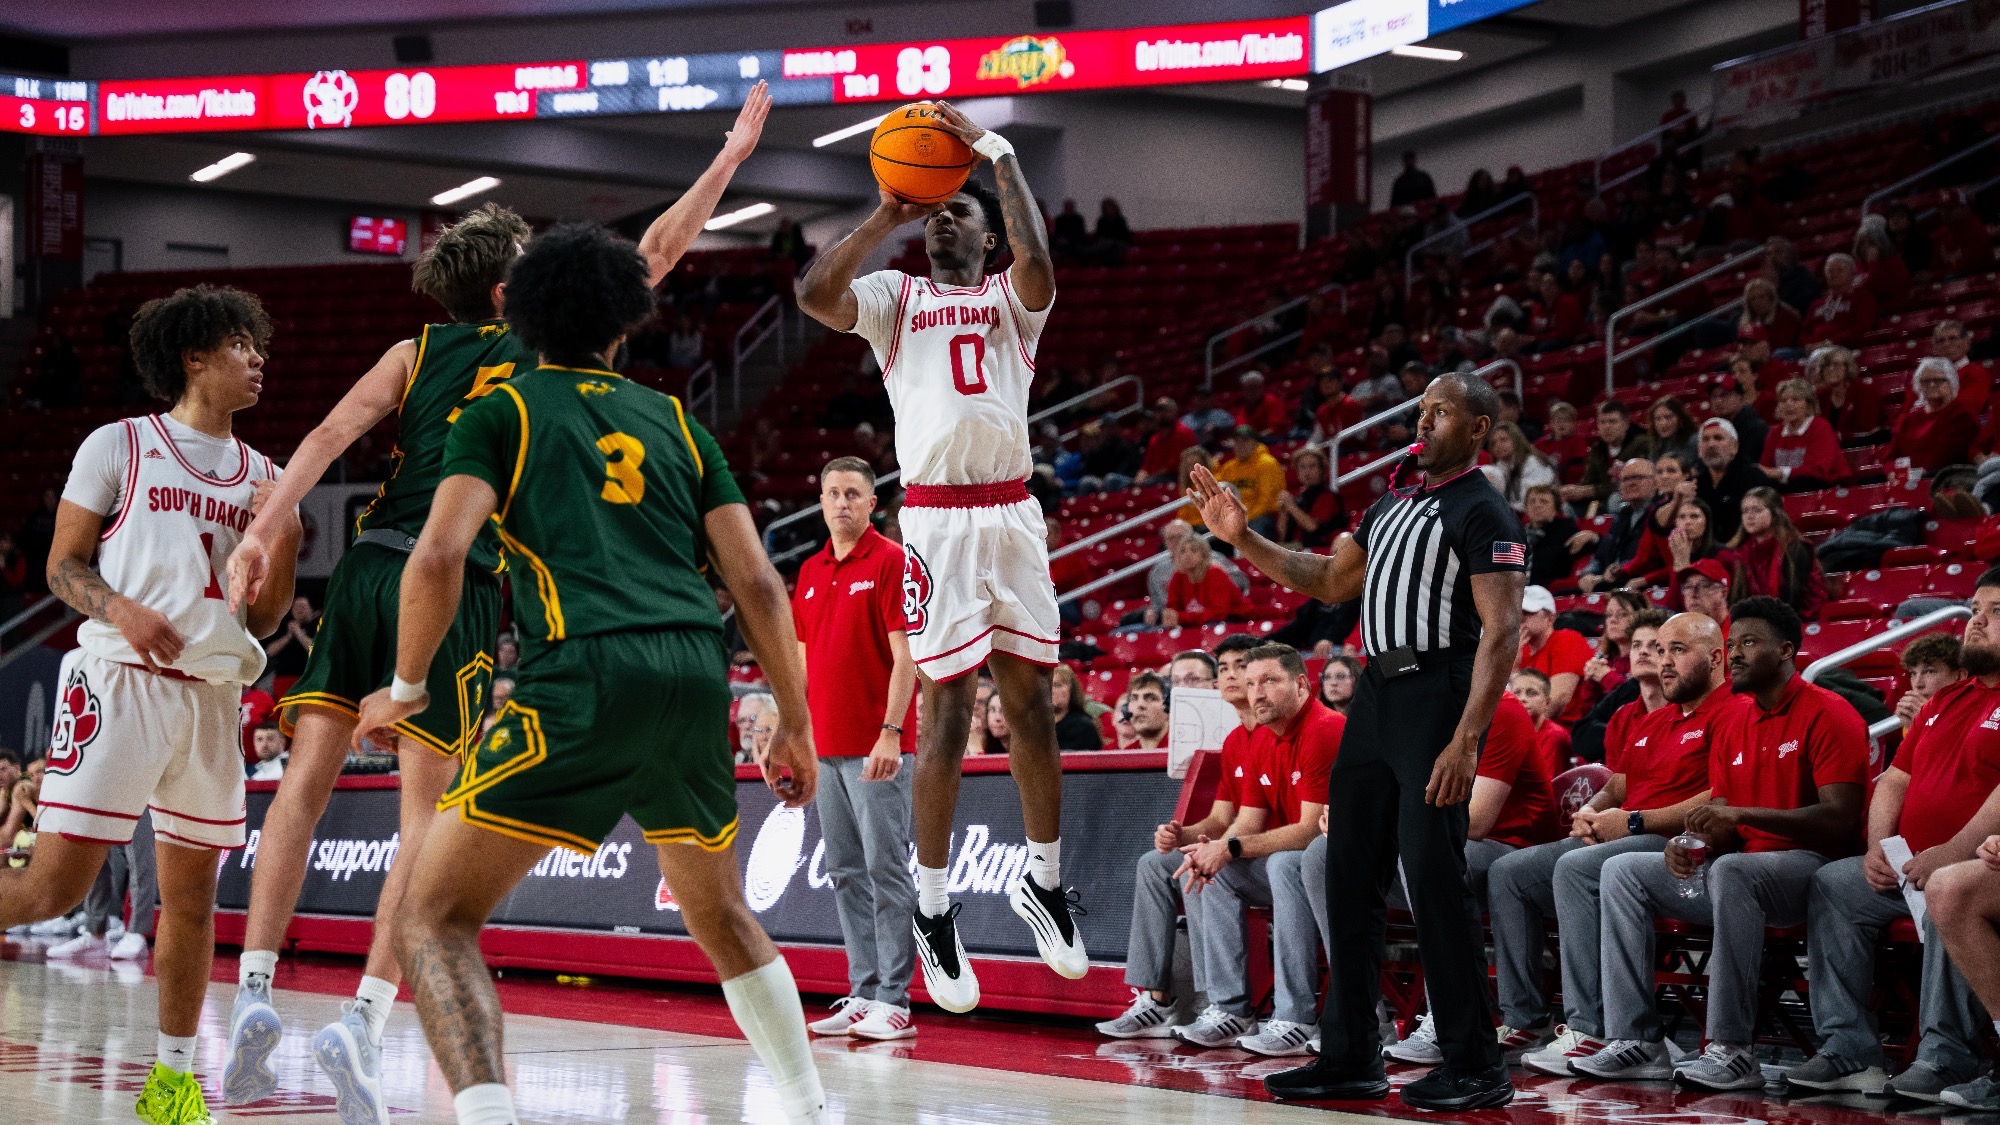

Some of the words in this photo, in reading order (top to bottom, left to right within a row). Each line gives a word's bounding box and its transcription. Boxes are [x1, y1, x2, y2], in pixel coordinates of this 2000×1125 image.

[897, 46, 950, 95] 83
[20, 104, 35, 127] 3
[55, 107, 84, 130] 15
[385, 72, 436, 119] 80
[911, 305, 957, 333] SOUTH
[949, 333, 988, 396] 0
[596, 431, 645, 505] 3
[148, 486, 202, 518] SOUTH
[199, 532, 225, 600] 1
